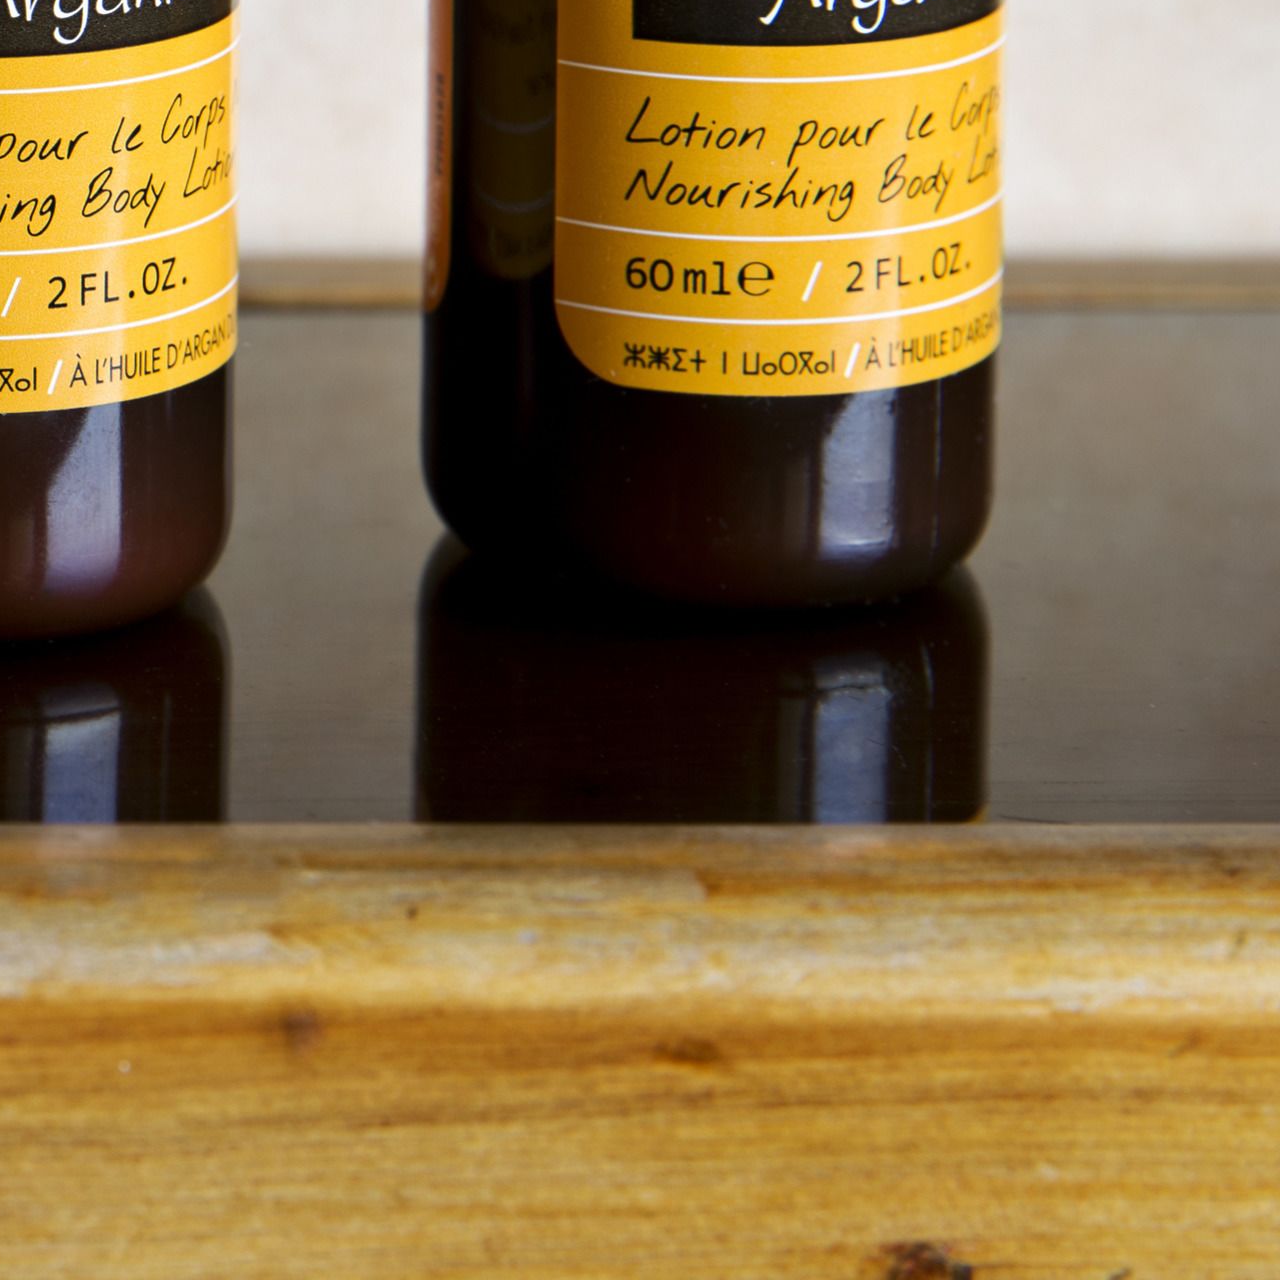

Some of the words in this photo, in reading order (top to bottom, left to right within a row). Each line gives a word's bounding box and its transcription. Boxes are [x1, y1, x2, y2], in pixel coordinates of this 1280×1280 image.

[111, 116, 145, 155] le
[160, 92, 226, 150] Corps
[624, 96, 766, 151] Lotion
[786, 117, 885, 167] pour
[906, 104, 936, 141] le
[950, 80, 1001, 136] Corp
[80, 167, 167, 228] Body
[182, 145, 235, 198] Lotio
[624, 162, 855, 222] Nourishing
[876, 154, 954, 214] Body
[68, 353, 88, 388] À
[95, 346, 161, 385] L'HUILE
[864, 336, 882, 370] À
